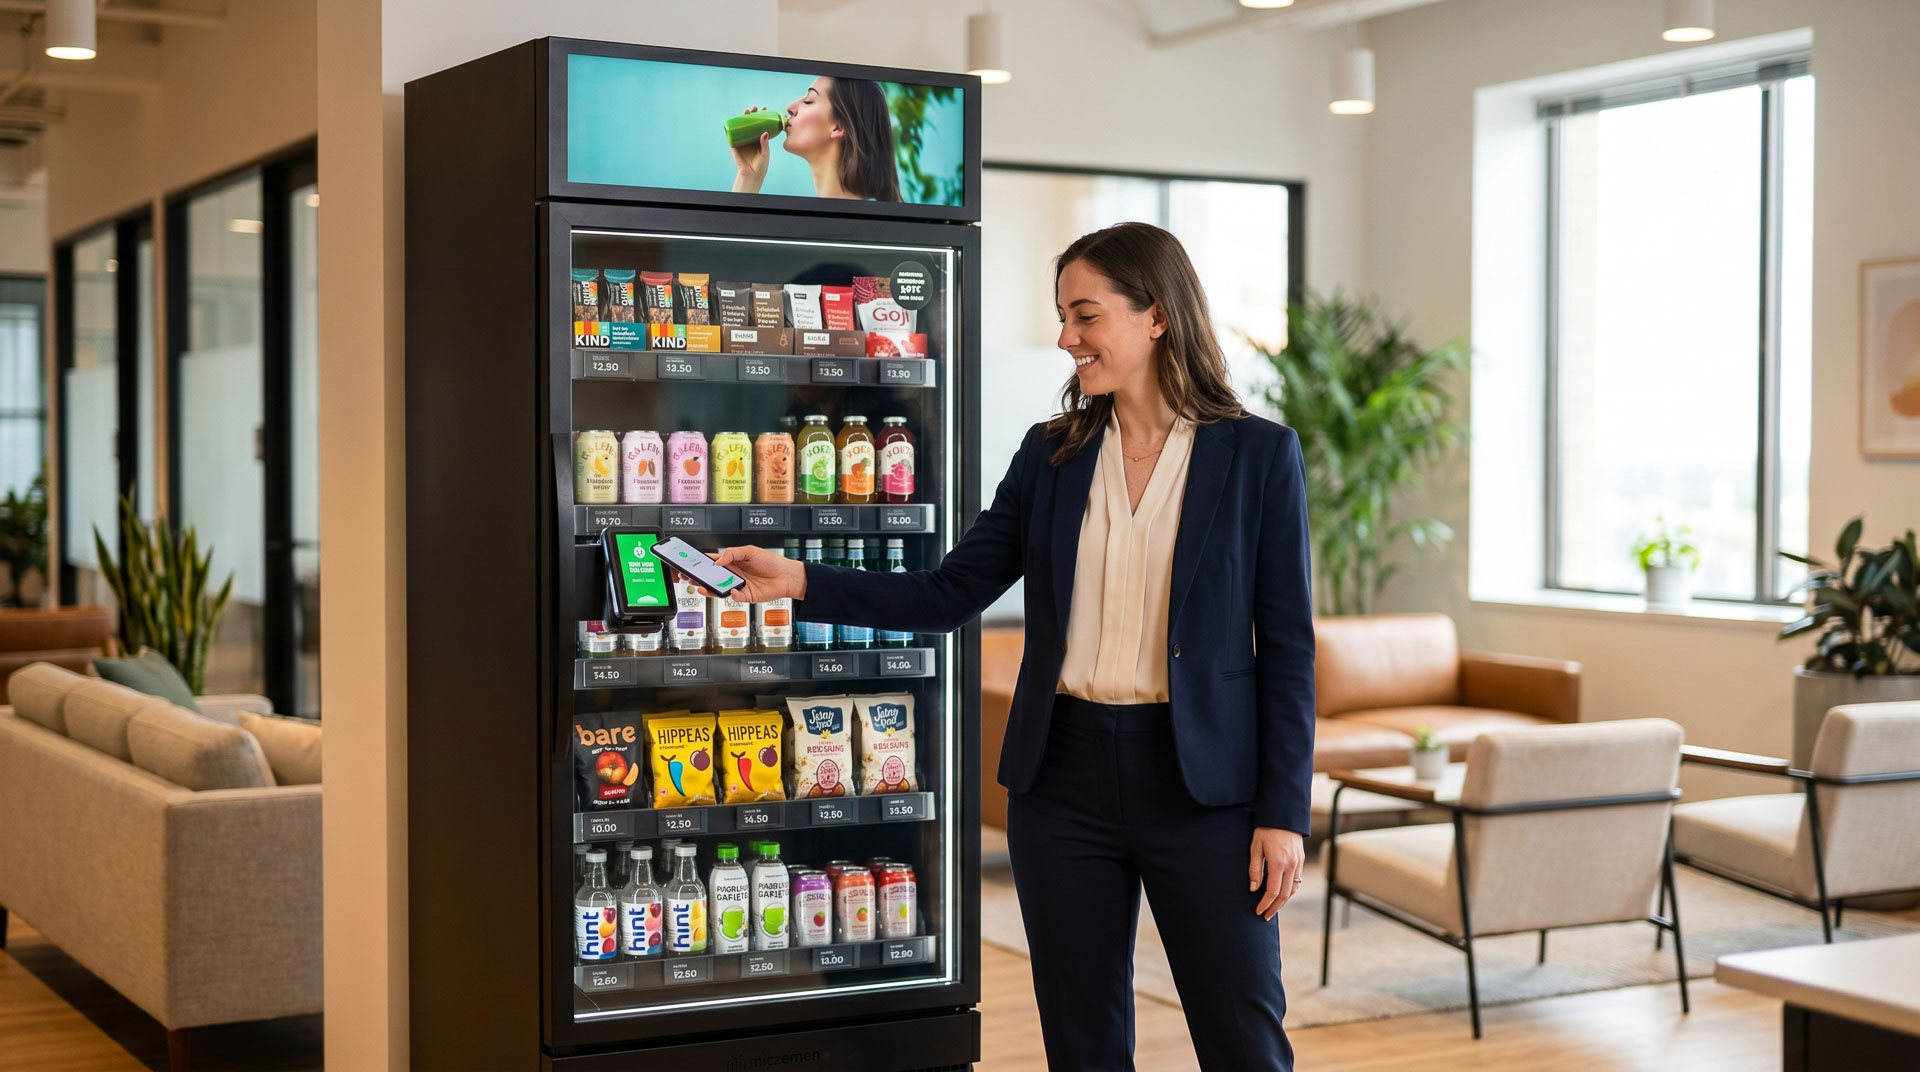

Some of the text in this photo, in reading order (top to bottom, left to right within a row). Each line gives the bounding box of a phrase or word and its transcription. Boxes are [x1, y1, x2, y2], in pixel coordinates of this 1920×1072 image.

[872, 307, 910, 326] Goji
[575, 335, 610, 347] KIND
[652, 337, 686, 349] KIND
[576, 724, 636, 746] bare
[658, 727, 710, 744] HIPPEAS
[728, 725, 778, 741] HIPPEAS
[582, 911, 599, 956] hint
[629, 907, 645, 951] hint
[673, 904, 690, 948] hint
